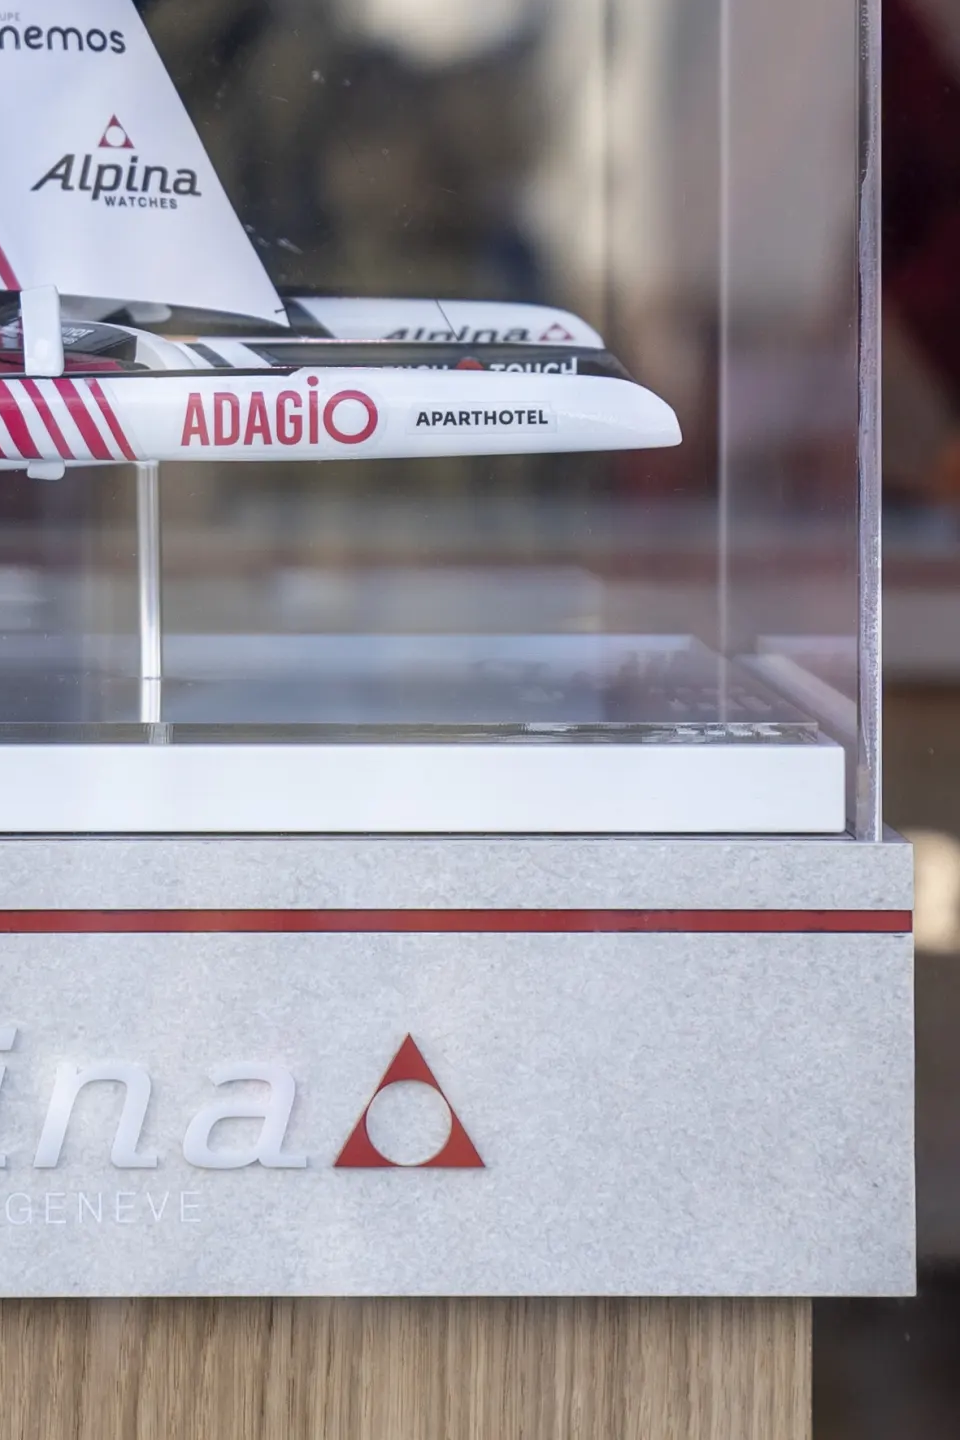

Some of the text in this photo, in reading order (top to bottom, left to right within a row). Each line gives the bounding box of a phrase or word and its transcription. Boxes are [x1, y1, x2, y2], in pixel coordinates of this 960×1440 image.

[30, 153, 203, 202] Alpina
[104, 195, 178, 210] WATCHES
[416, 409, 549, 427] APARTHOTEL
[4, 1191, 204, 1226] GENEVE
